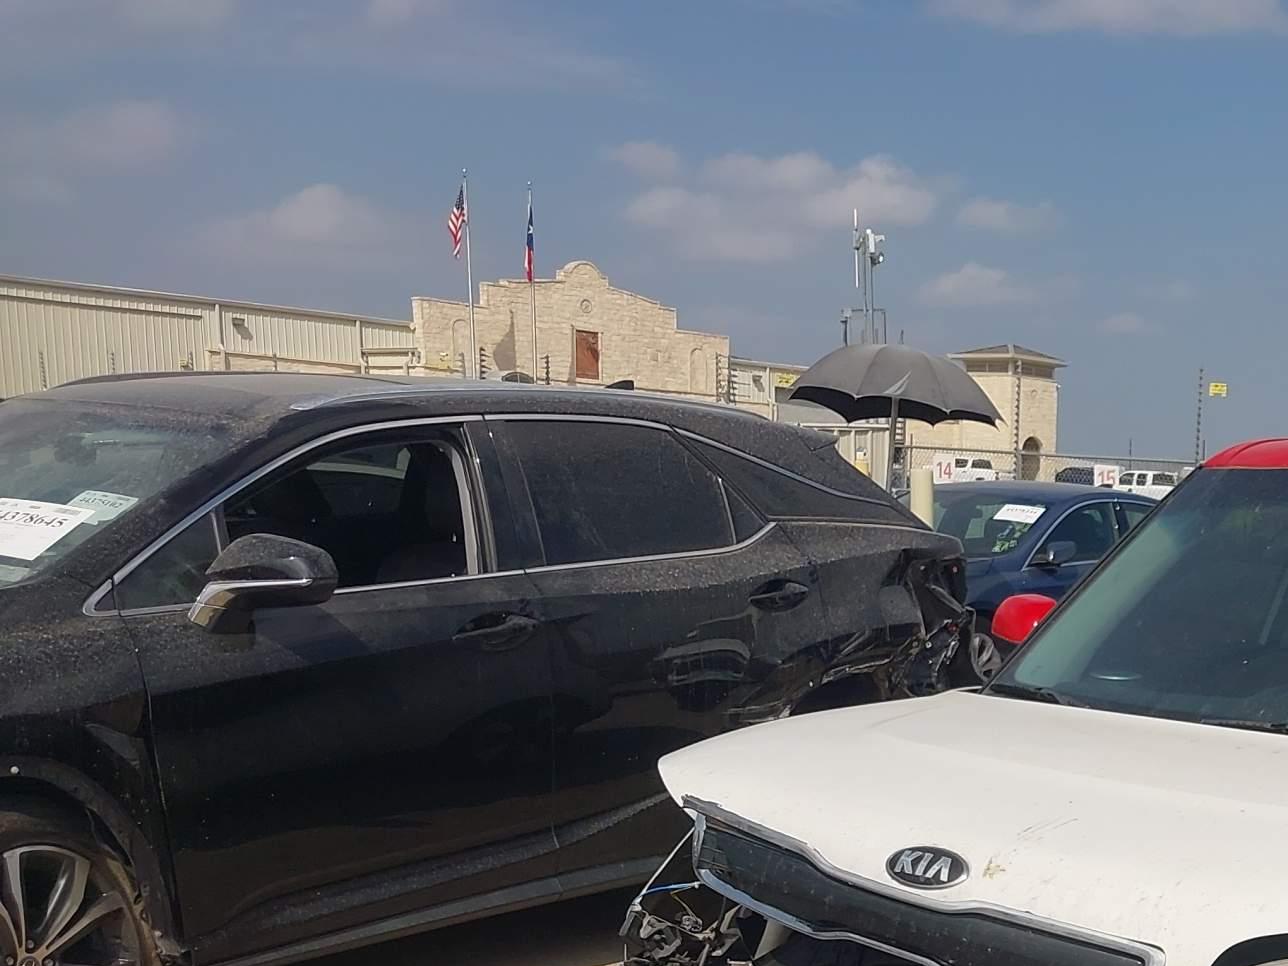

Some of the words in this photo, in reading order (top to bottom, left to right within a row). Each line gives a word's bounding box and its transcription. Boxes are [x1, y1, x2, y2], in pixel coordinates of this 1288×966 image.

[936, 460, 953, 480] 14
[1097, 470, 1116, 484] 15
[893, 849, 953, 883] KIA
